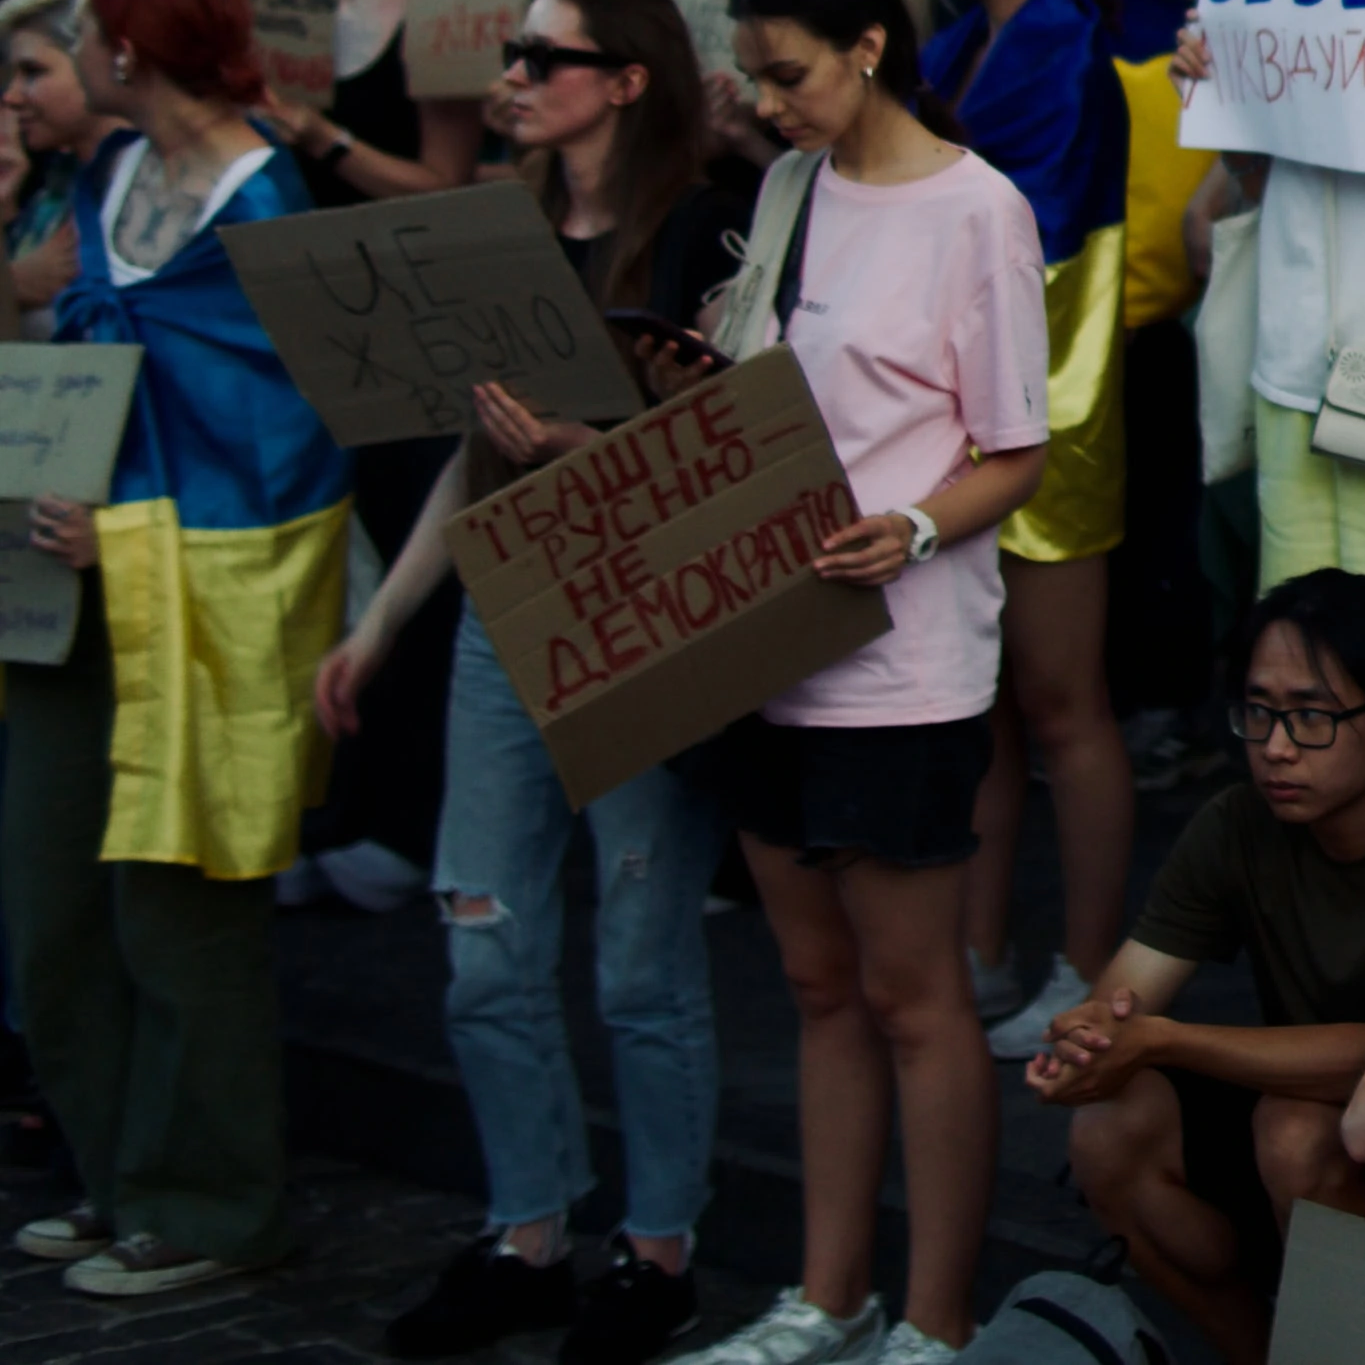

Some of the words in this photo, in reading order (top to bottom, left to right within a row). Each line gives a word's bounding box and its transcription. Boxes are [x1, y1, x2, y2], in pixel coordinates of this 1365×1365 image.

[408, 295, 576, 378] БУЛО
[541, 439, 754, 579] РУСНЮ
[562, 543, 658, 620] НЕ
